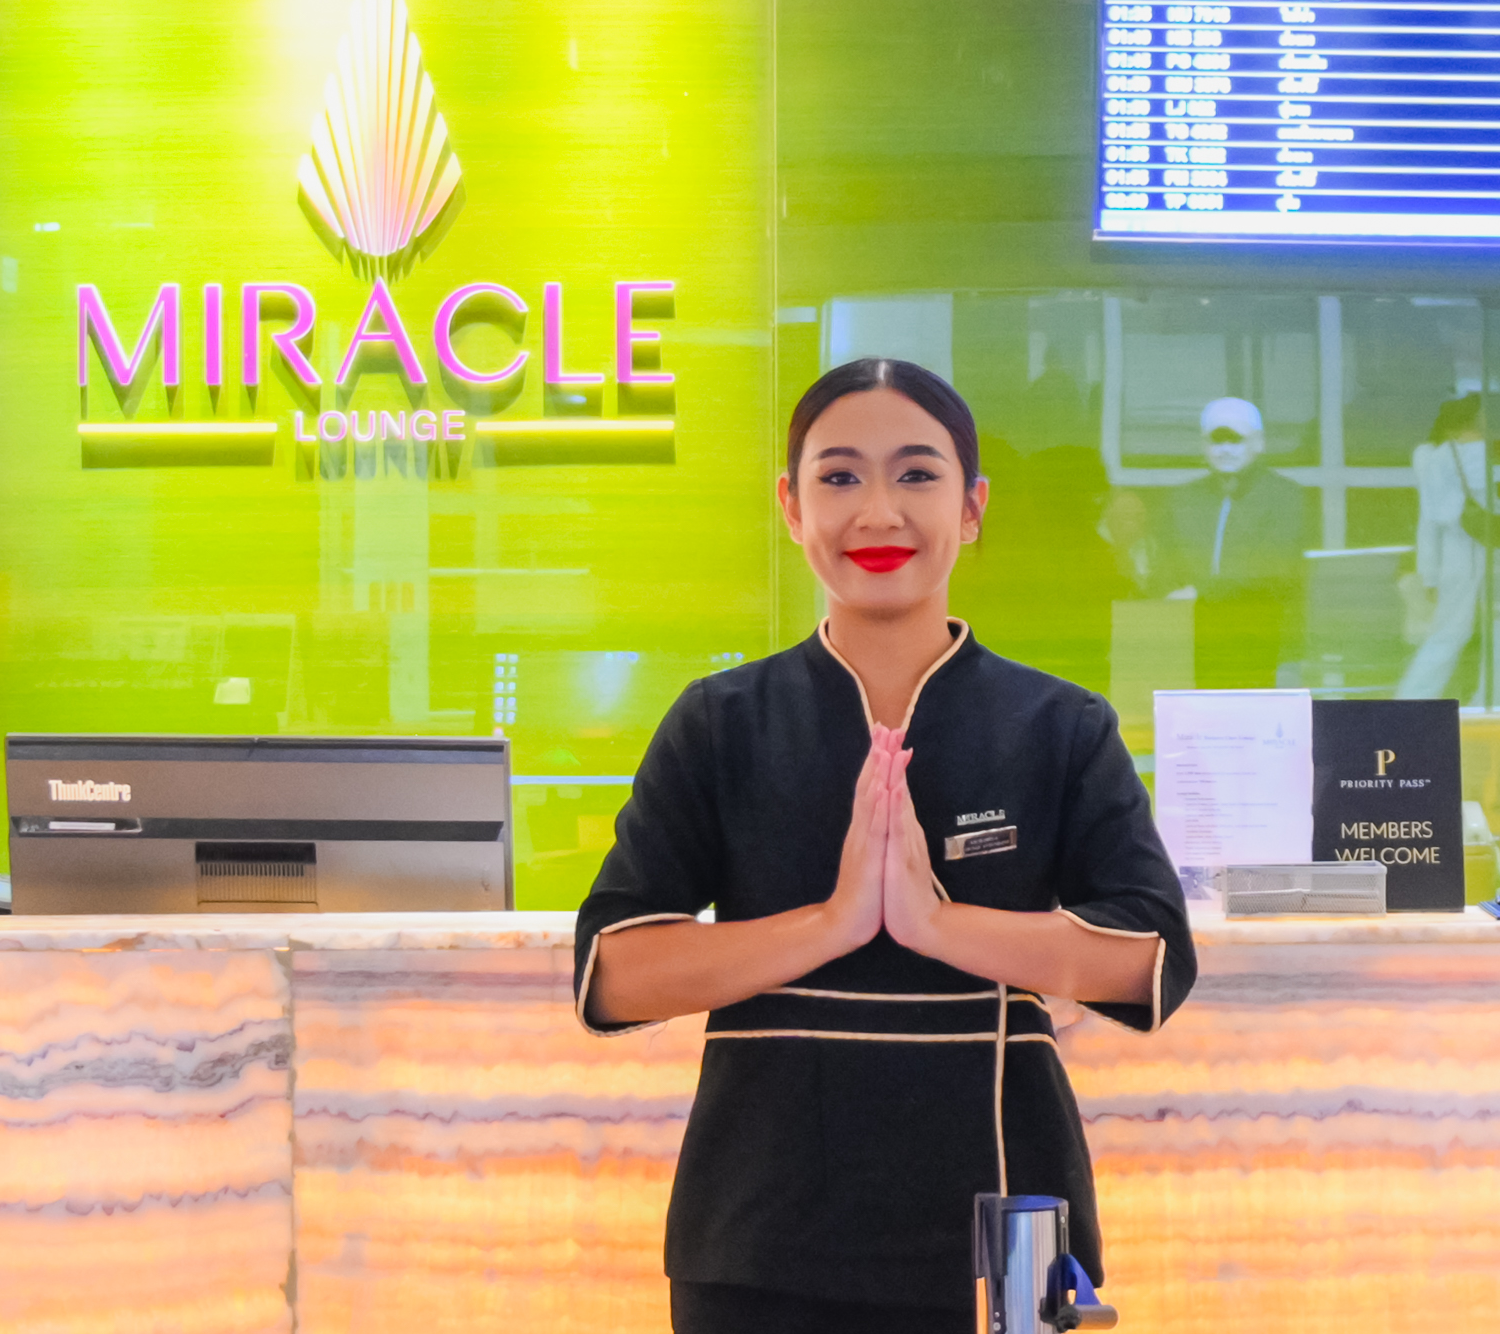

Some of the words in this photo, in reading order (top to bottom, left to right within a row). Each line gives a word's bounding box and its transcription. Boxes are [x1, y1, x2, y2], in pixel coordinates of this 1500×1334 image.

[76, 276, 675, 386] MIRACLE
[294, 410, 466, 441] LOUNGE
[1374, 749, 1397, 776] P
[48, 779, 132, 802] ThinkCentre
[1340, 779, 1393, 788] PRIORITY
[1341, 820, 1434, 839] MEMBERS
